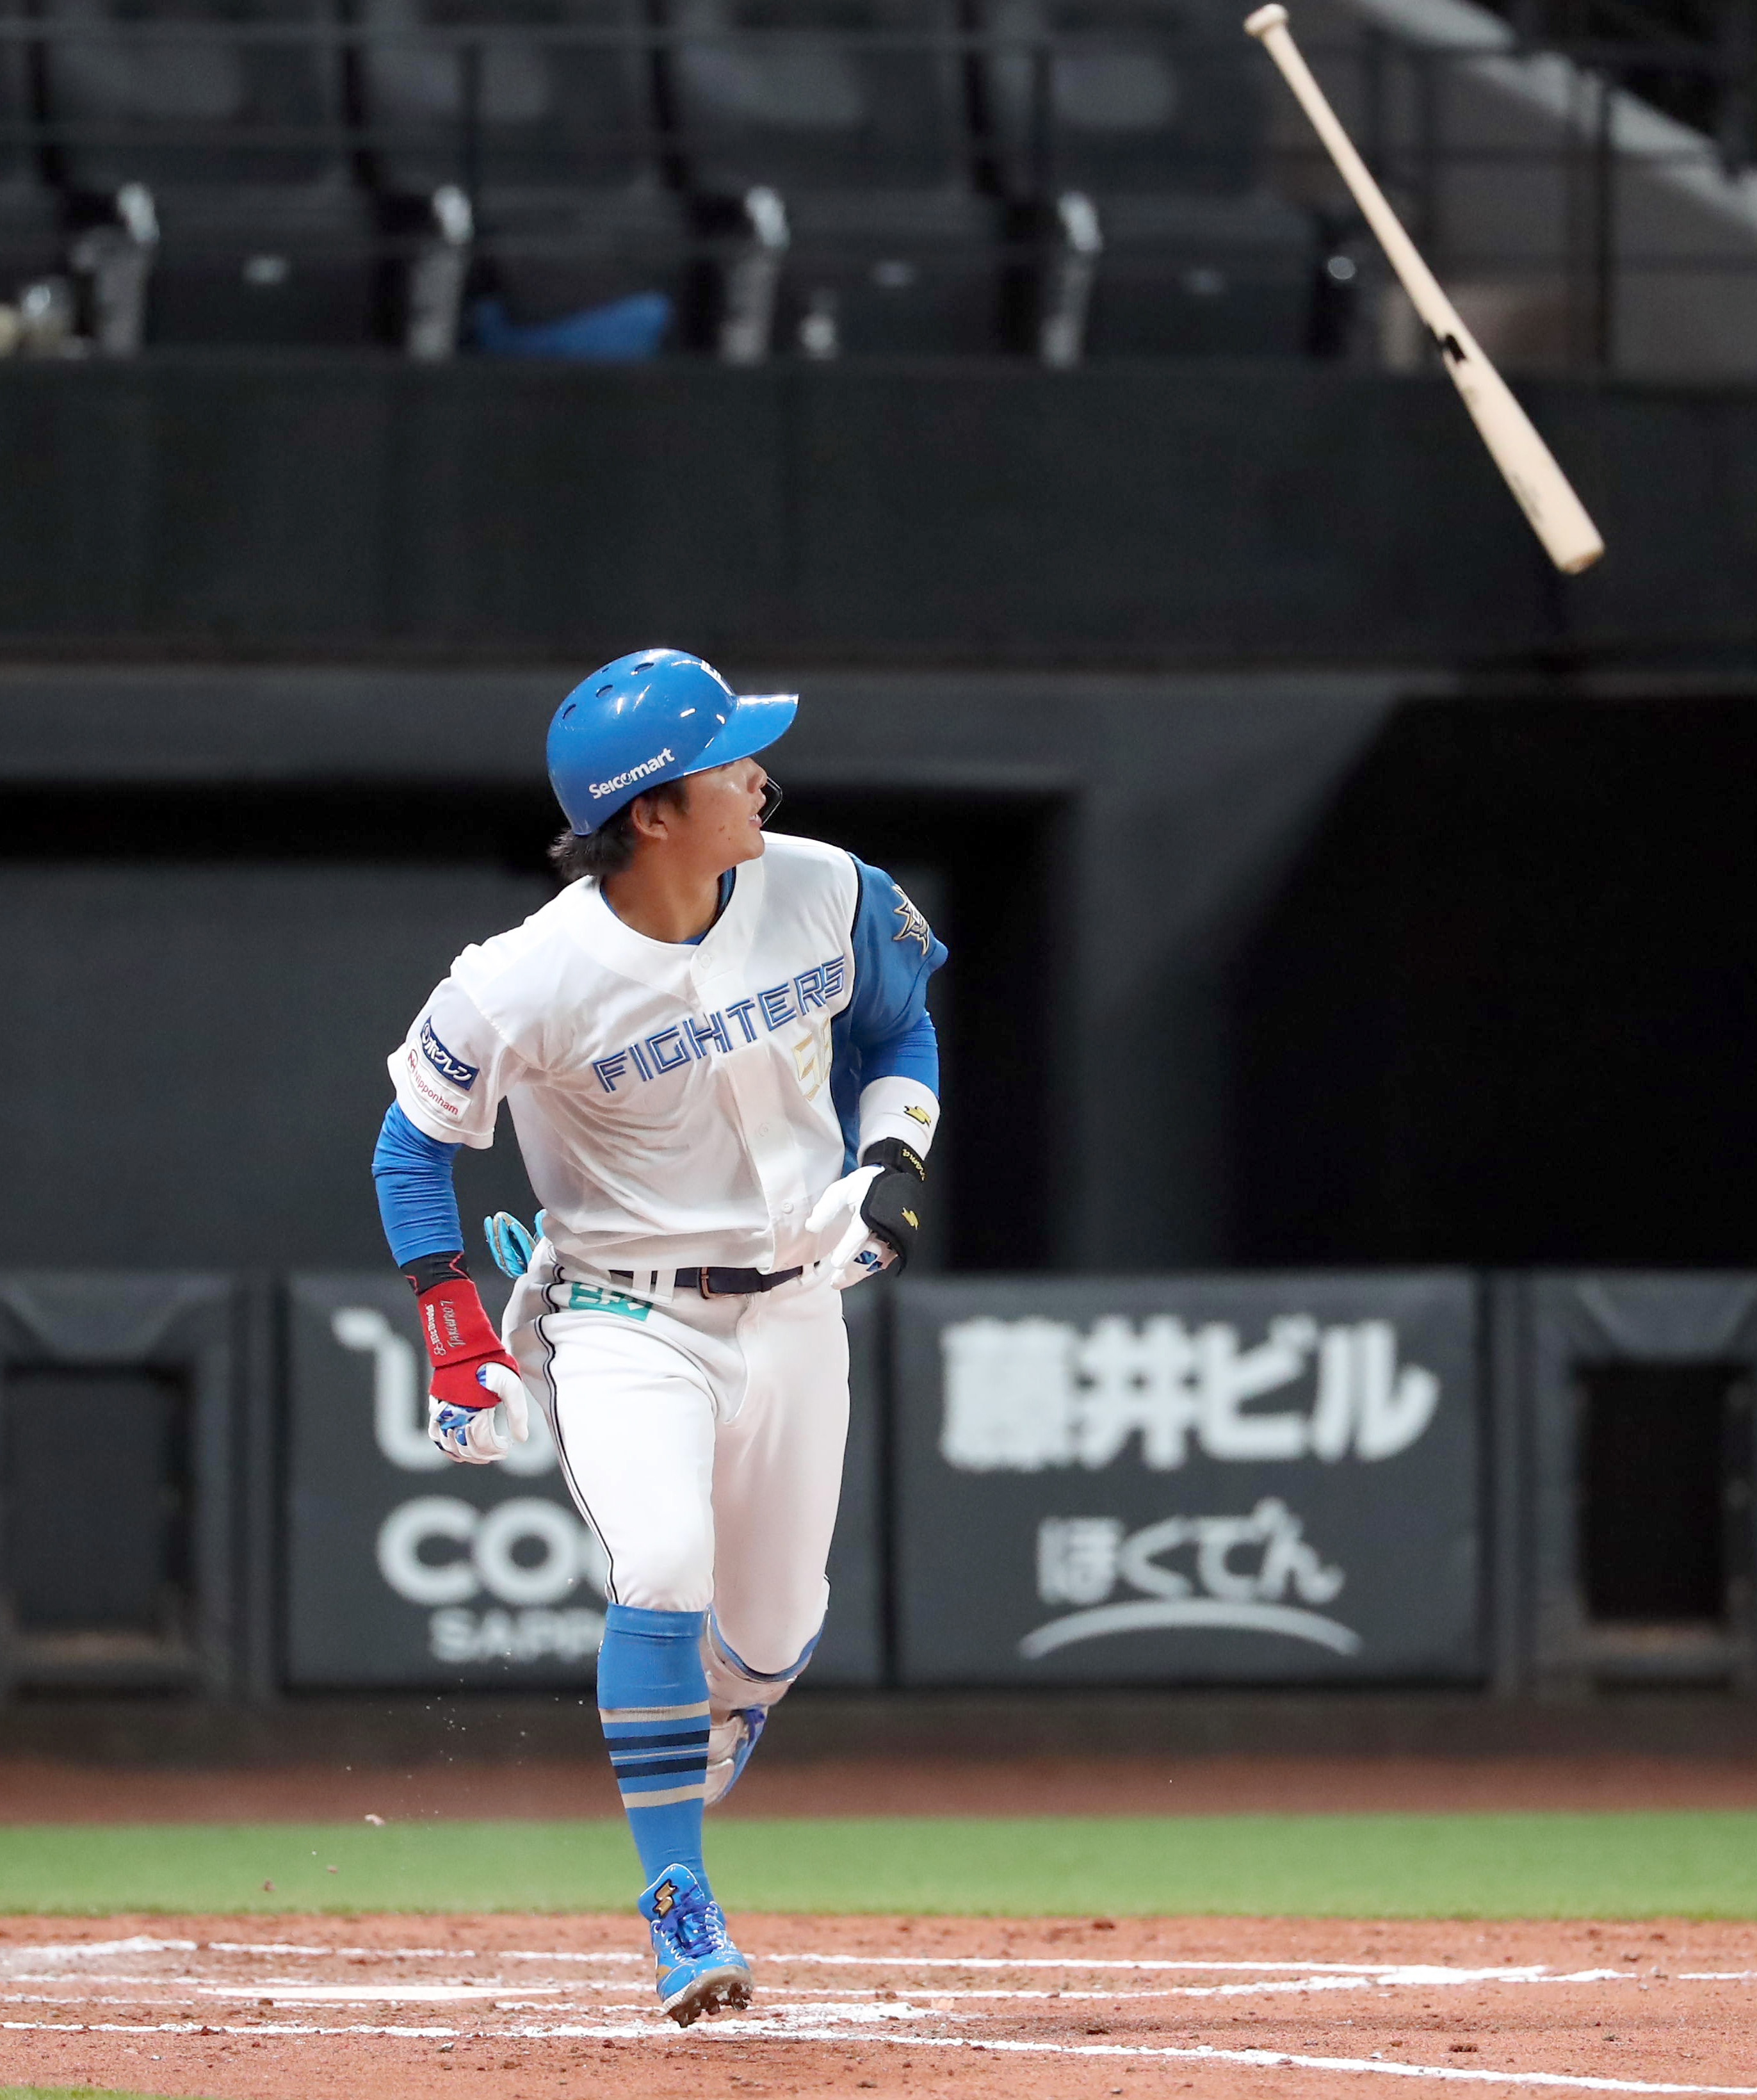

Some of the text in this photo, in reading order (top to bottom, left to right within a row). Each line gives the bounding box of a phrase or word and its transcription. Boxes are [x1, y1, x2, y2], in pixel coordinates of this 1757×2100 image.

[588, 747, 675, 800] Seicomart
[592, 955, 845, 1093] FIGHTERS
[424, 1037, 472, 1082] ホクレン
[414, 1070, 459, 1116] Nipponham
[376, 1495, 608, 1606] CO
